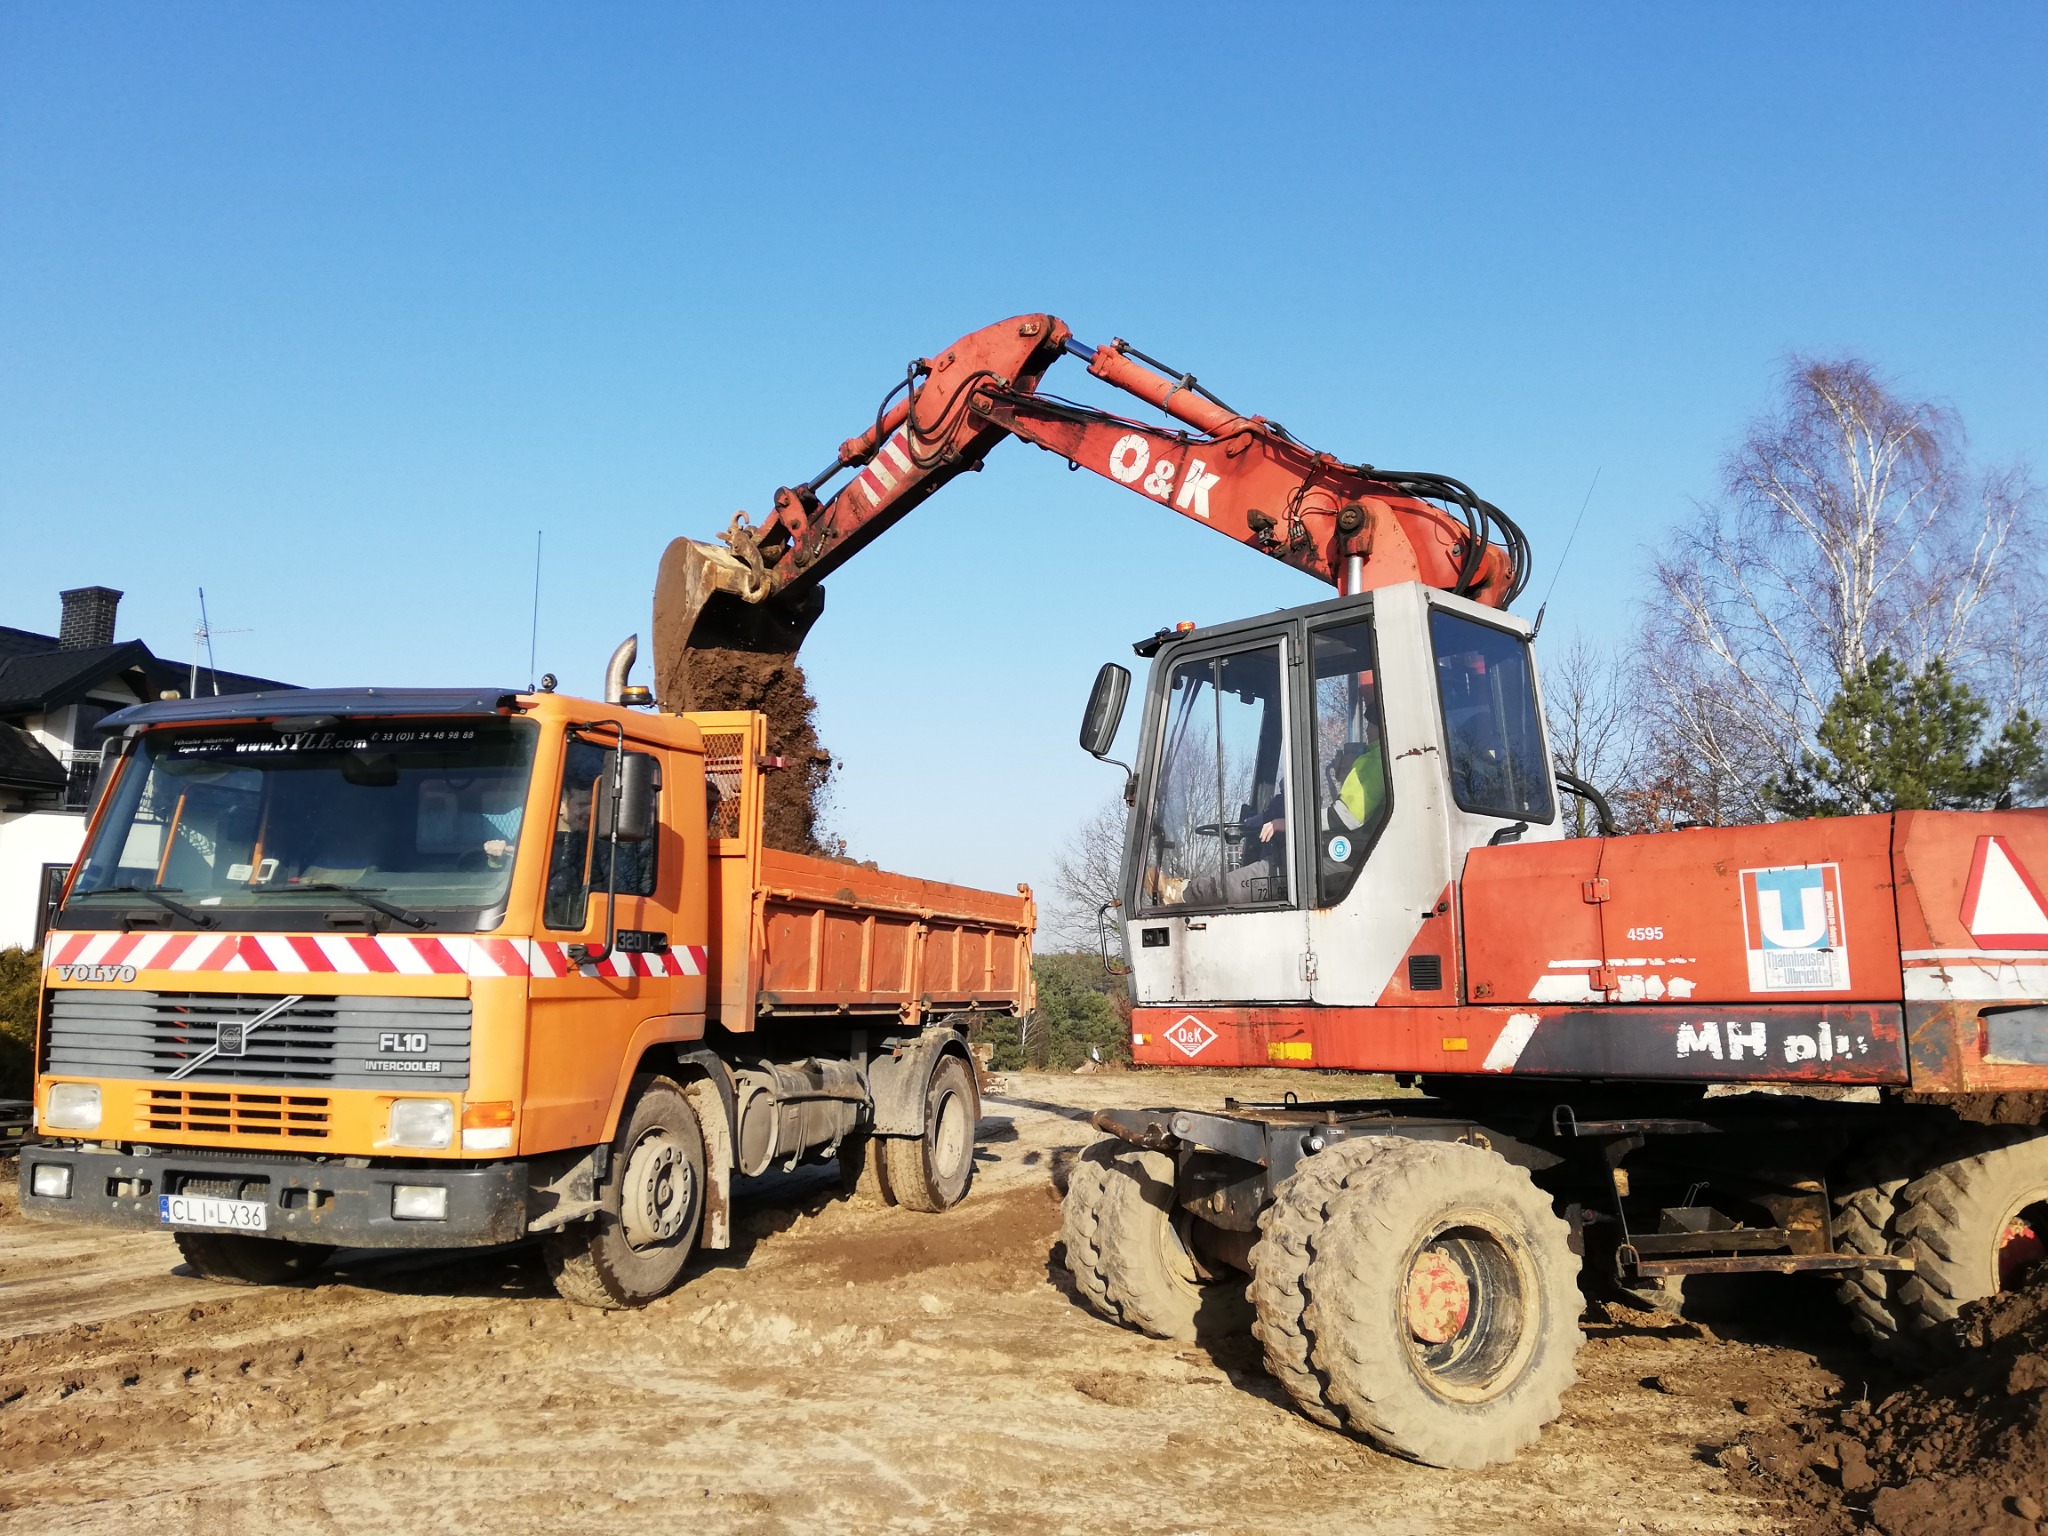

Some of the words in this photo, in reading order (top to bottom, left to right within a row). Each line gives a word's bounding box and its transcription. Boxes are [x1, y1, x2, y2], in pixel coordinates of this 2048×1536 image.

[1109, 434, 1221, 519] O&K
[236, 732, 366, 752] www.SYLE.com
[382, 732, 393, 741] 33
[396, 732, 415, 741] (0)1
[419, 731, 430, 740] 34
[433, 731, 444, 740] 48
[447, 731, 459, 740] 98
[462, 731, 474, 739] 88
[1241, 879, 1250, 888] CE
[618, 931, 642, 950] 320
[1627, 926, 1664, 941] 4595
[1766, 950, 1827, 969] Thannhauser
[56, 963, 137, 983] VOLVO
[1783, 966, 1823, 985] Ulbricht
[380, 1032, 427, 1052] FL10
[1177, 1027, 1203, 1043] O&K
[1676, 1021, 1767, 1061] MH
[364, 1060, 441, 1072] INTERCOOLER
[172, 1200, 207, 1223] CLI
[217, 1202, 262, 1227] LX36
